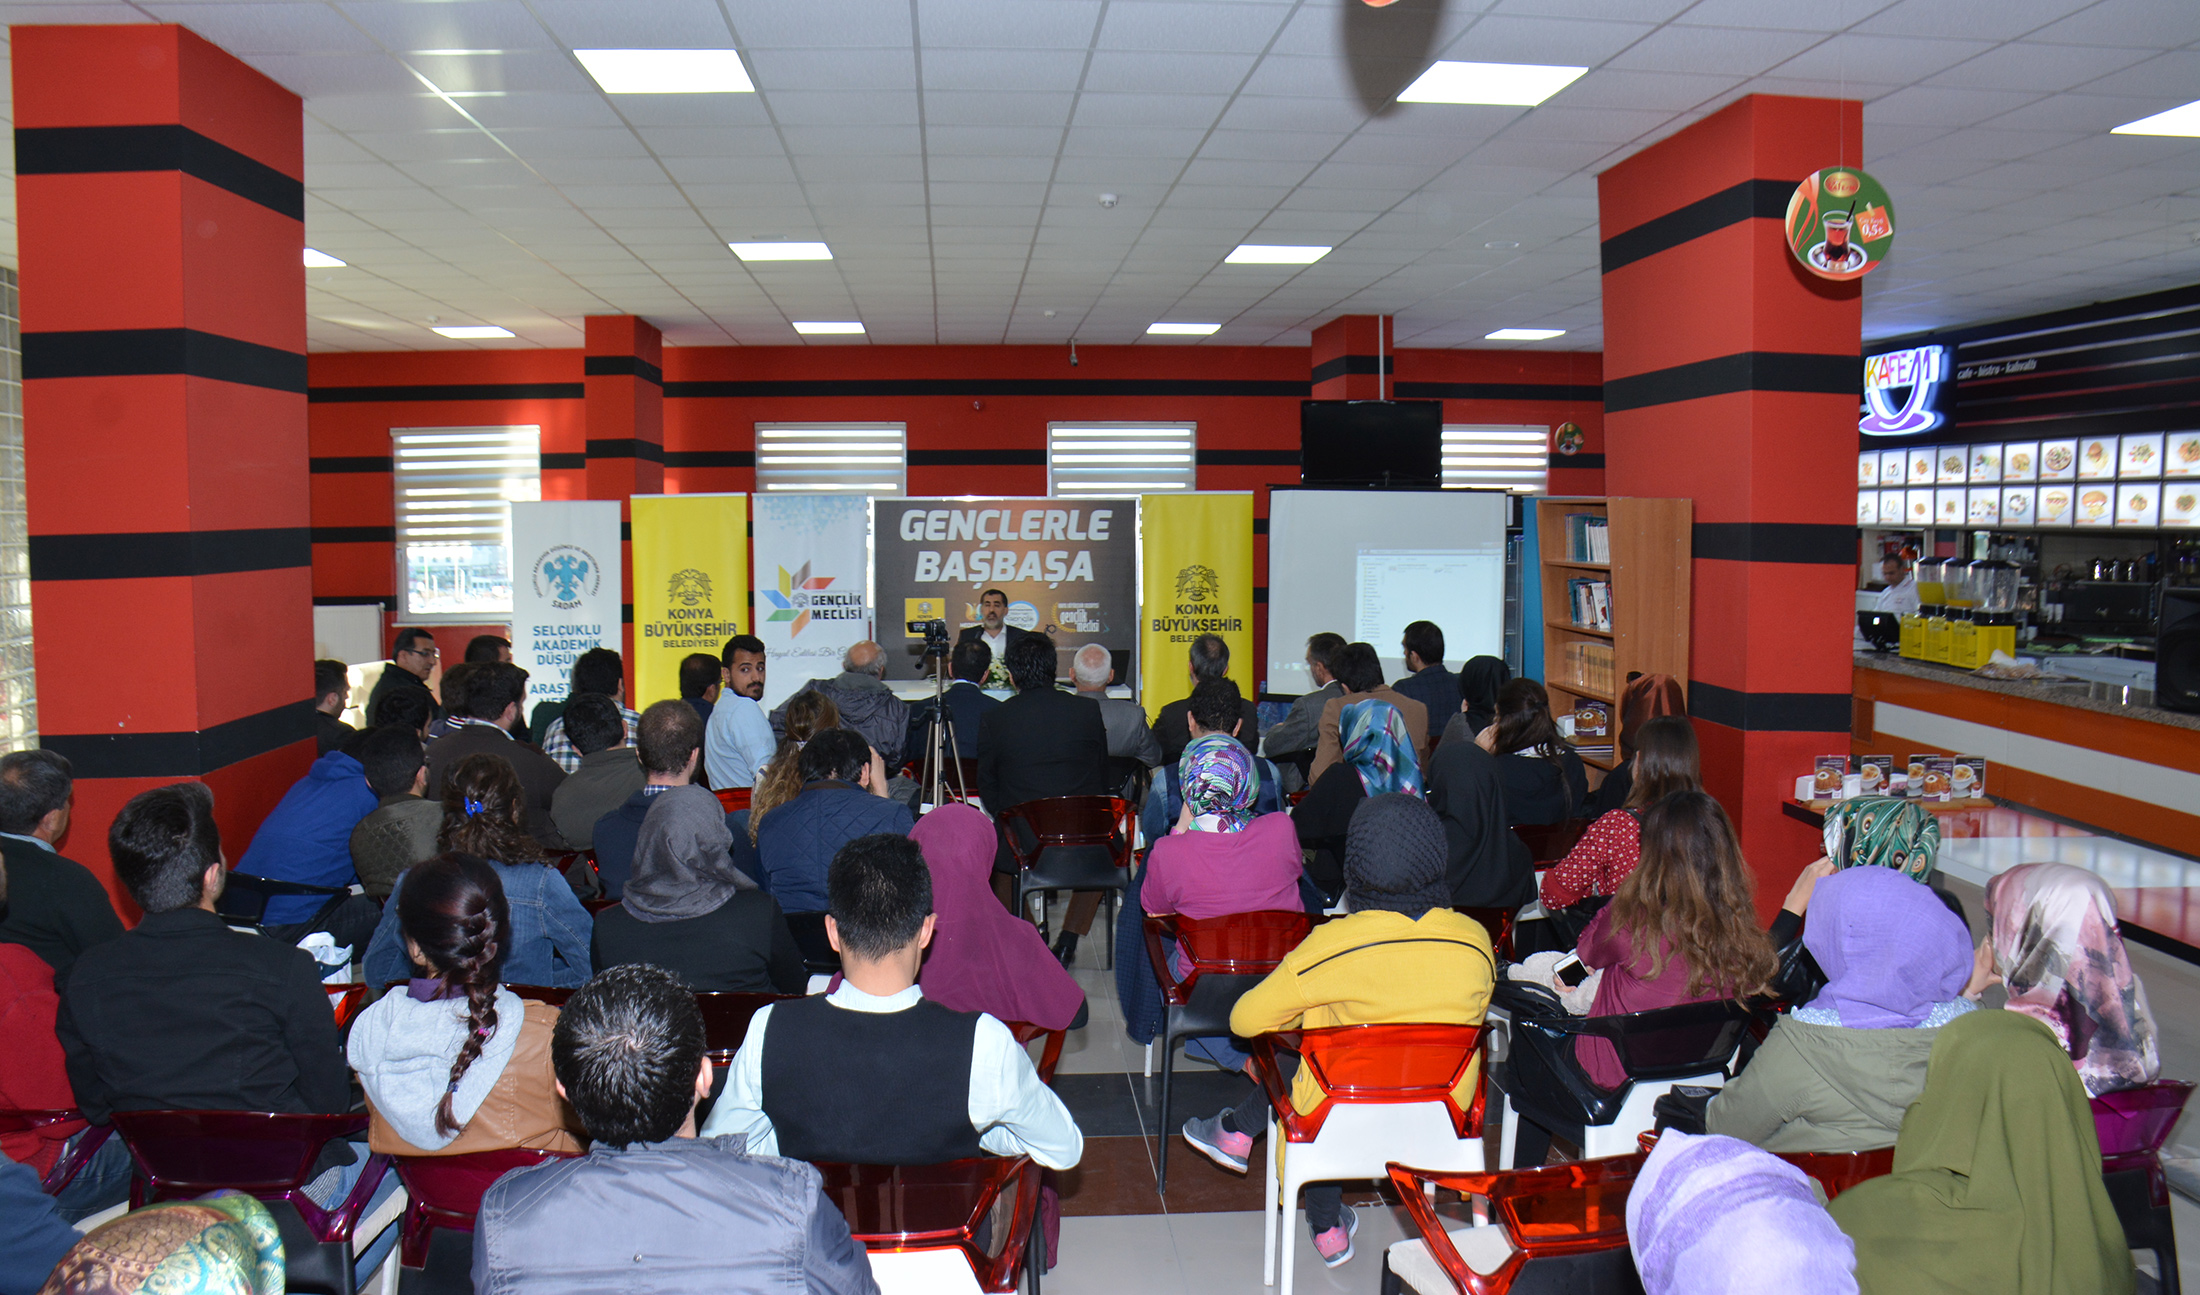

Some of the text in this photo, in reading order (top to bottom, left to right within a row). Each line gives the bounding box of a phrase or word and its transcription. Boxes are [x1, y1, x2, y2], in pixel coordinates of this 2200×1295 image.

[900, 508, 1113, 549] GENÇLERLE
[914, 550, 1095, 590] BAŞBAŞA
[551, 599, 583, 610] SADAM
[811, 592, 862, 608] GENÇLİK
[668, 608, 714, 620] KONYA
[811, 606, 862, 620] MECLİSİ
[1175, 604, 1220, 615] KONYA
[532, 624, 602, 639] SELÇUKLU
[644, 619, 738, 637] BÜYÜKŞEHİR
[1152, 615, 1242, 633] BÜYÜKŞEHİR
[532, 636, 602, 651] AKADEMİK
[663, 637, 719, 648] BELEDİYESİ
